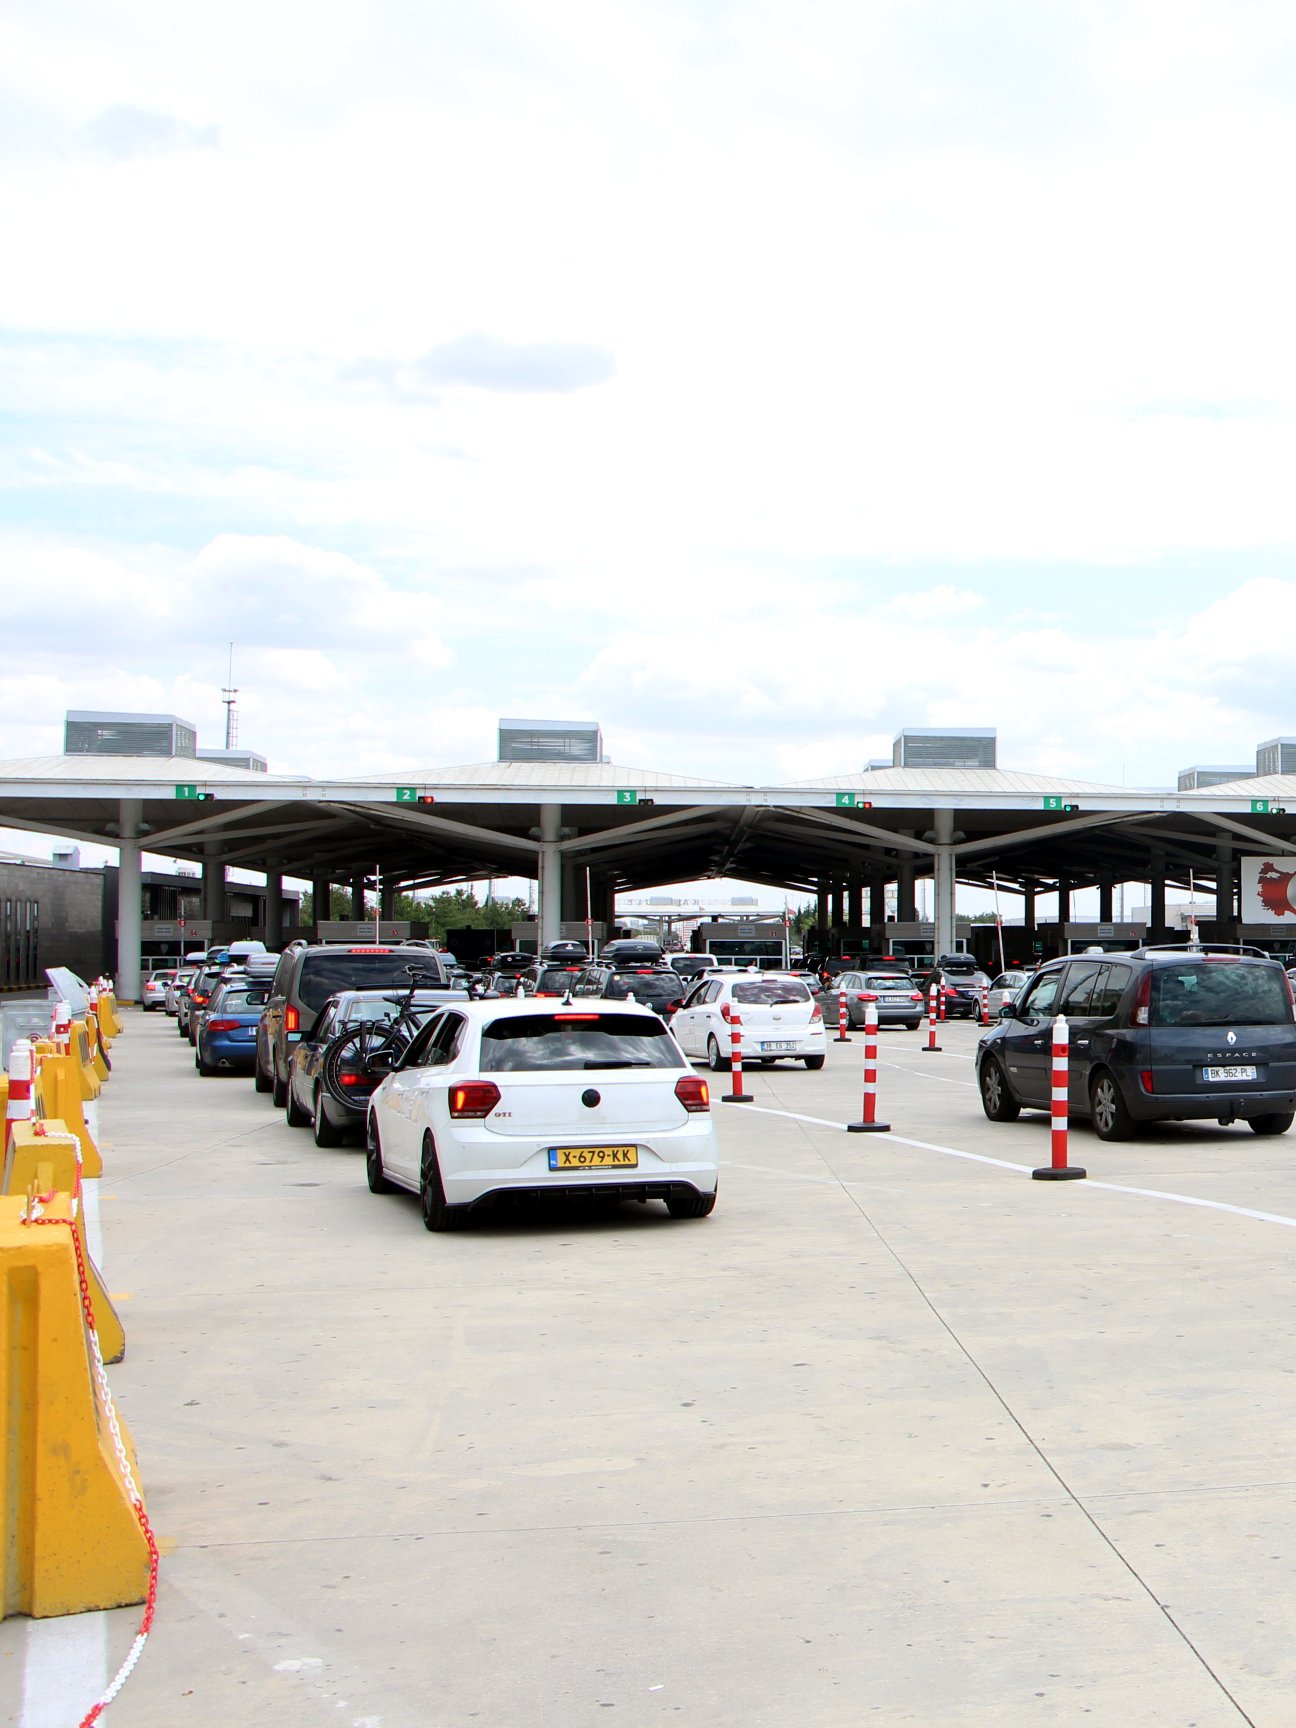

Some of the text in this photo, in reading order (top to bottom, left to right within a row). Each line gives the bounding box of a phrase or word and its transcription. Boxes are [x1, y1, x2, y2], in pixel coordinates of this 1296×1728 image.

[183, 786, 190, 797] 1
[402, 789, 411, 800] 2
[623, 792, 631, 802] 3
[841, 795, 850, 805] 4
[1049, 798, 1057, 808] 5
[1256, 801, 1264, 811] 6
[563, 1149, 632, 1164] X-679-KK
